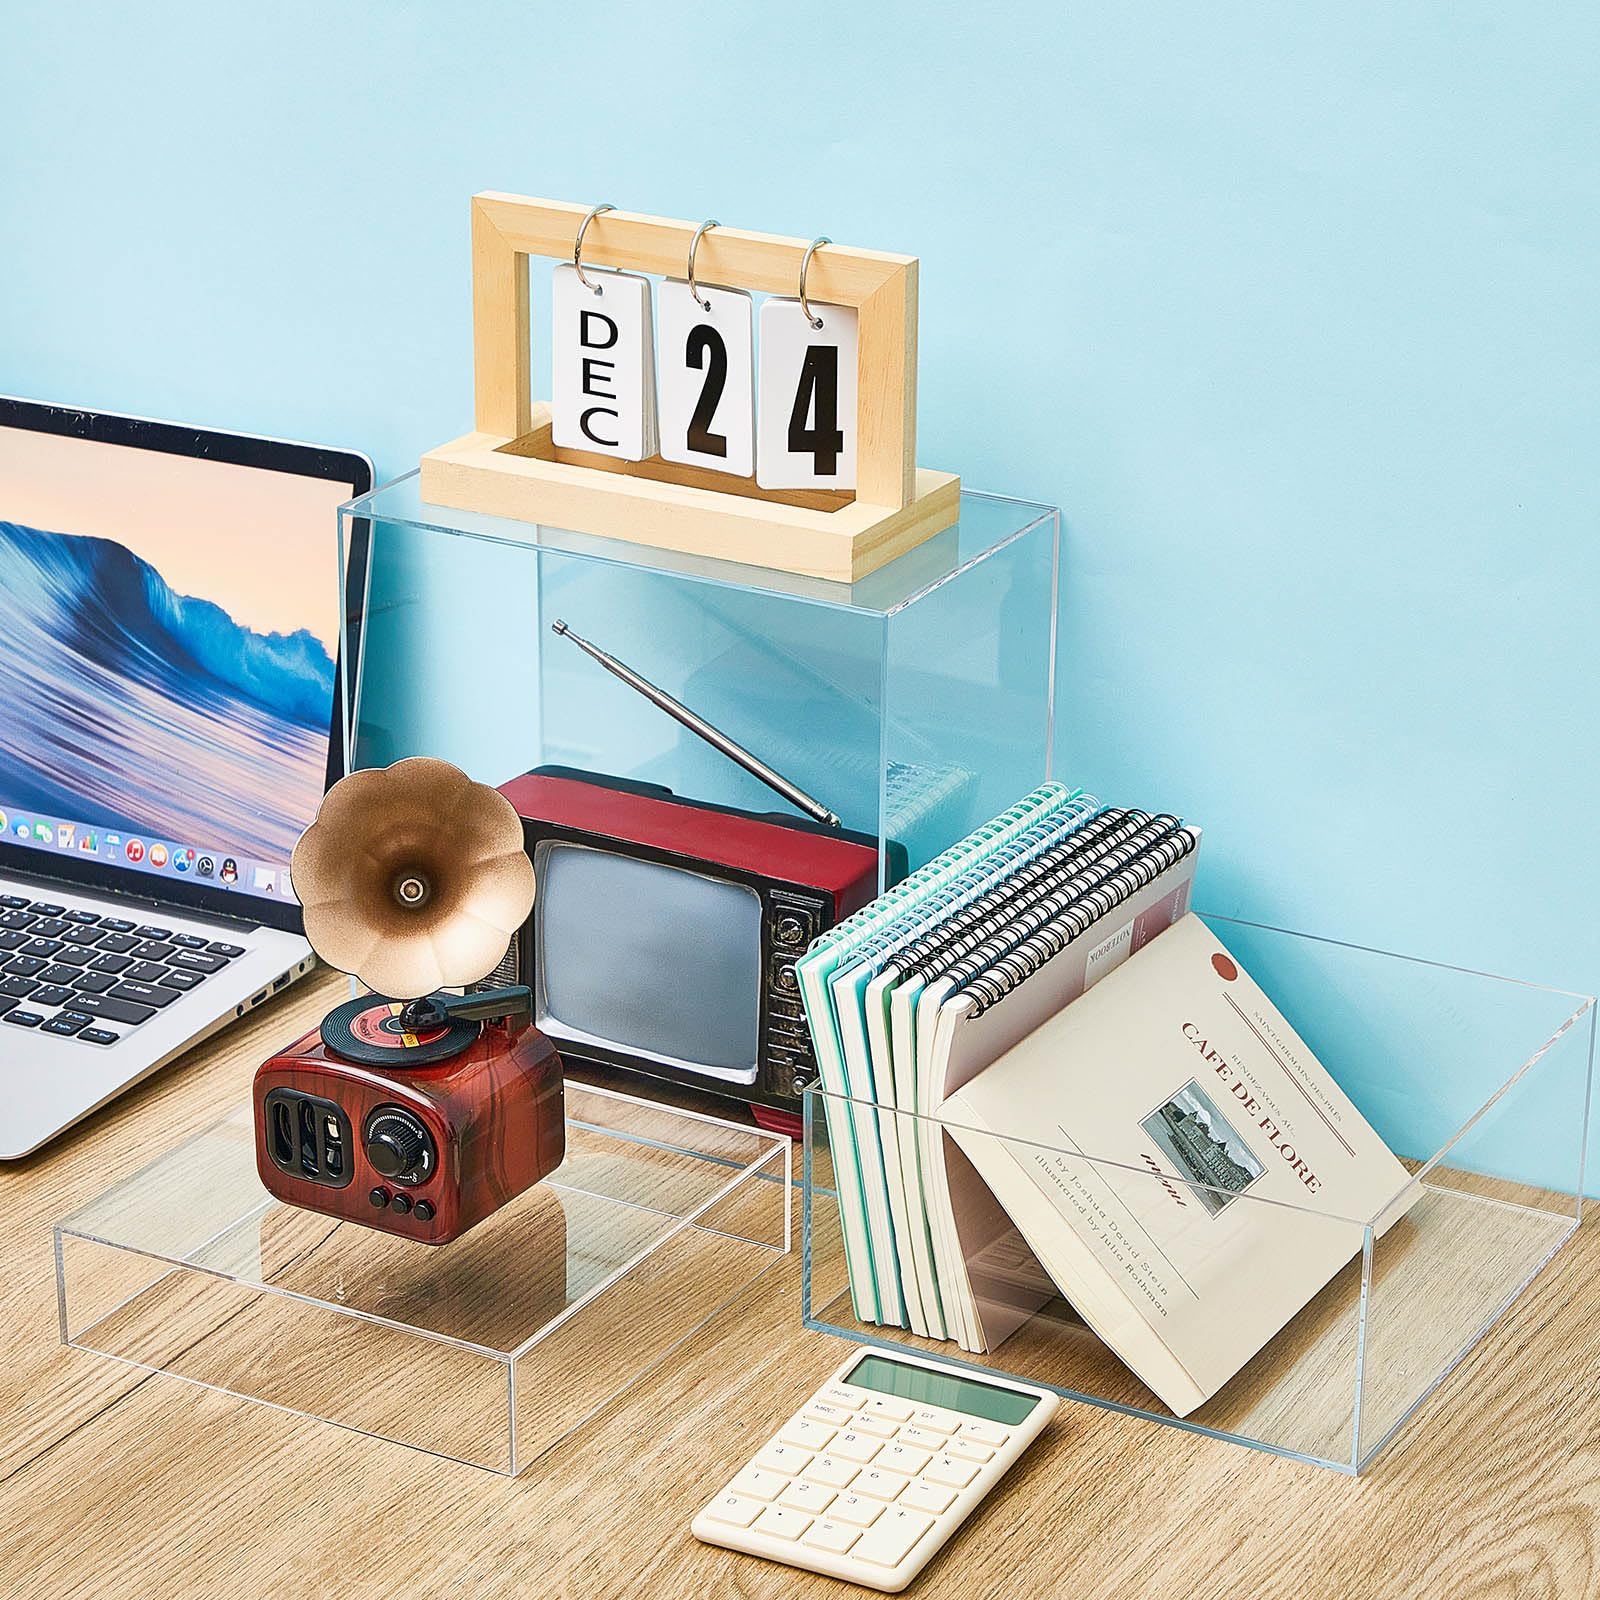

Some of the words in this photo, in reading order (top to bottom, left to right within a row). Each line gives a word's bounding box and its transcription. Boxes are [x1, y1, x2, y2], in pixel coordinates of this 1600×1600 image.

[580, 310, 619, 446] DEC
[1182, 1022, 1234, 1082] CAFE
[1229, 1079, 1262, 1117] DE
[1258, 1116, 1323, 1195] FLORE
[1034, 1154, 1087, 1215] illustrated
[1087, 1215, 1100, 1231] by
[1099, 1233, 1124, 1262] Julia
[1125, 1263, 1169, 1318] Rothman
[1055, 1157, 1069, 1173] by
[1069, 1175, 1107, 1219] Joshua
[1108, 1221, 1141, 1259] David
[1140, 1262, 1169, 1296] Stein
[799, 1484, 810, 1492] 2
[847, 1497, 858, 1505] 3
[823, 1459, 832, 1467] 5
[870, 1471, 880, 1479] 6
[894, 1446, 903, 1454] 9
